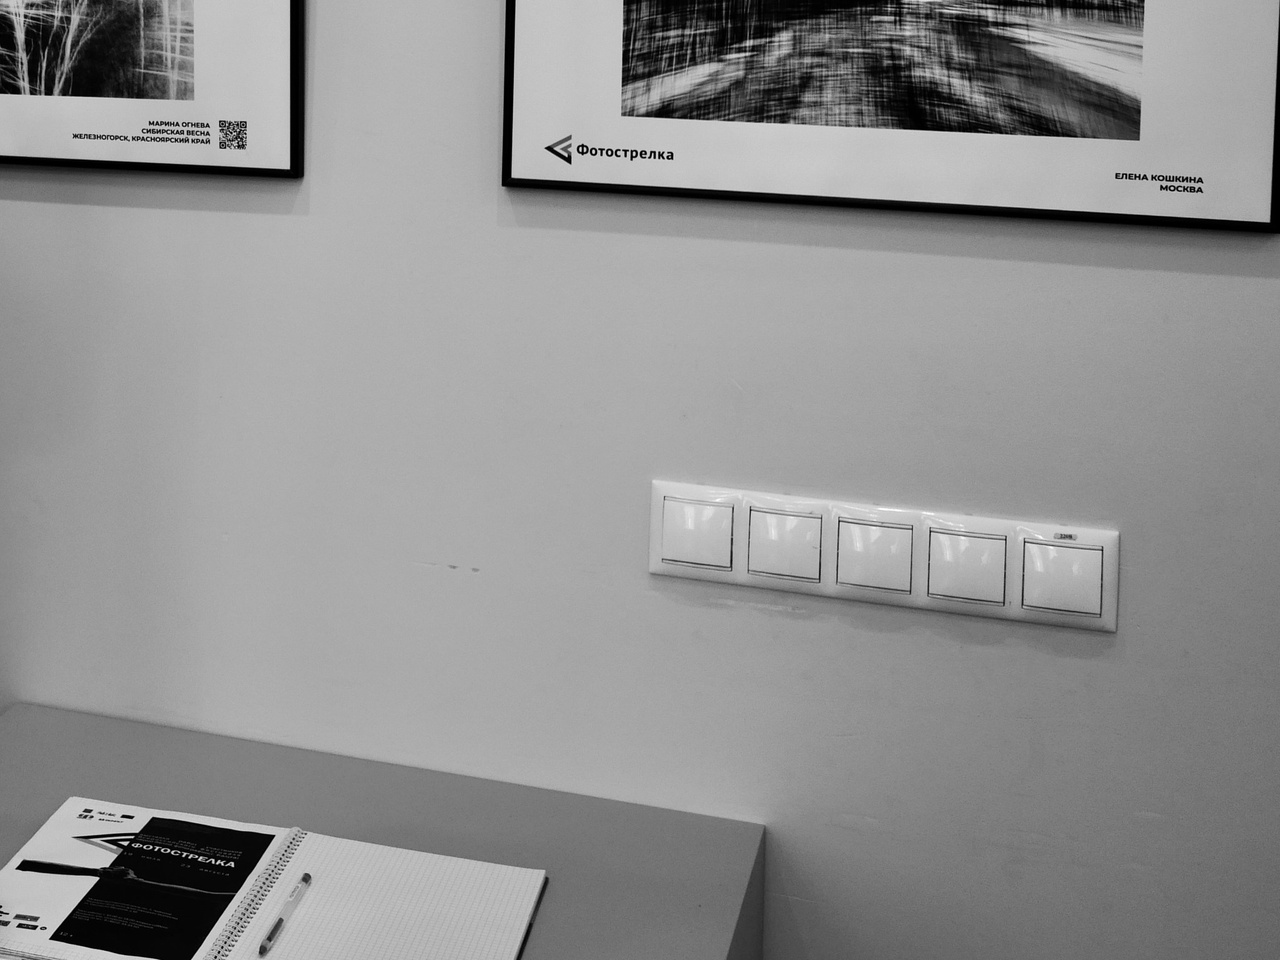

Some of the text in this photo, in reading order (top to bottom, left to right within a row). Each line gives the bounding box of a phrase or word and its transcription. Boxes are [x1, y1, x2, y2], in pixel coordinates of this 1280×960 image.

[148, 120, 210, 129] МАРИНА ОГНЕВА
[141, 128, 211, 137] СИБИРСКАЯ ВЕСНА
[72, 133, 211, 145] ЖЕЛЕЗНОГОРСК, КРАСНОЯРСКИЙ КРАЙ
[576, 143, 674, 161] Фотострелка
[1114, 172, 1204, 184] ЕЛЕНА КОШКИНА
[1159, 184, 1204, 194] МОСКВА
[131, 842, 235, 868] ФОТОСТРЕЛКА
